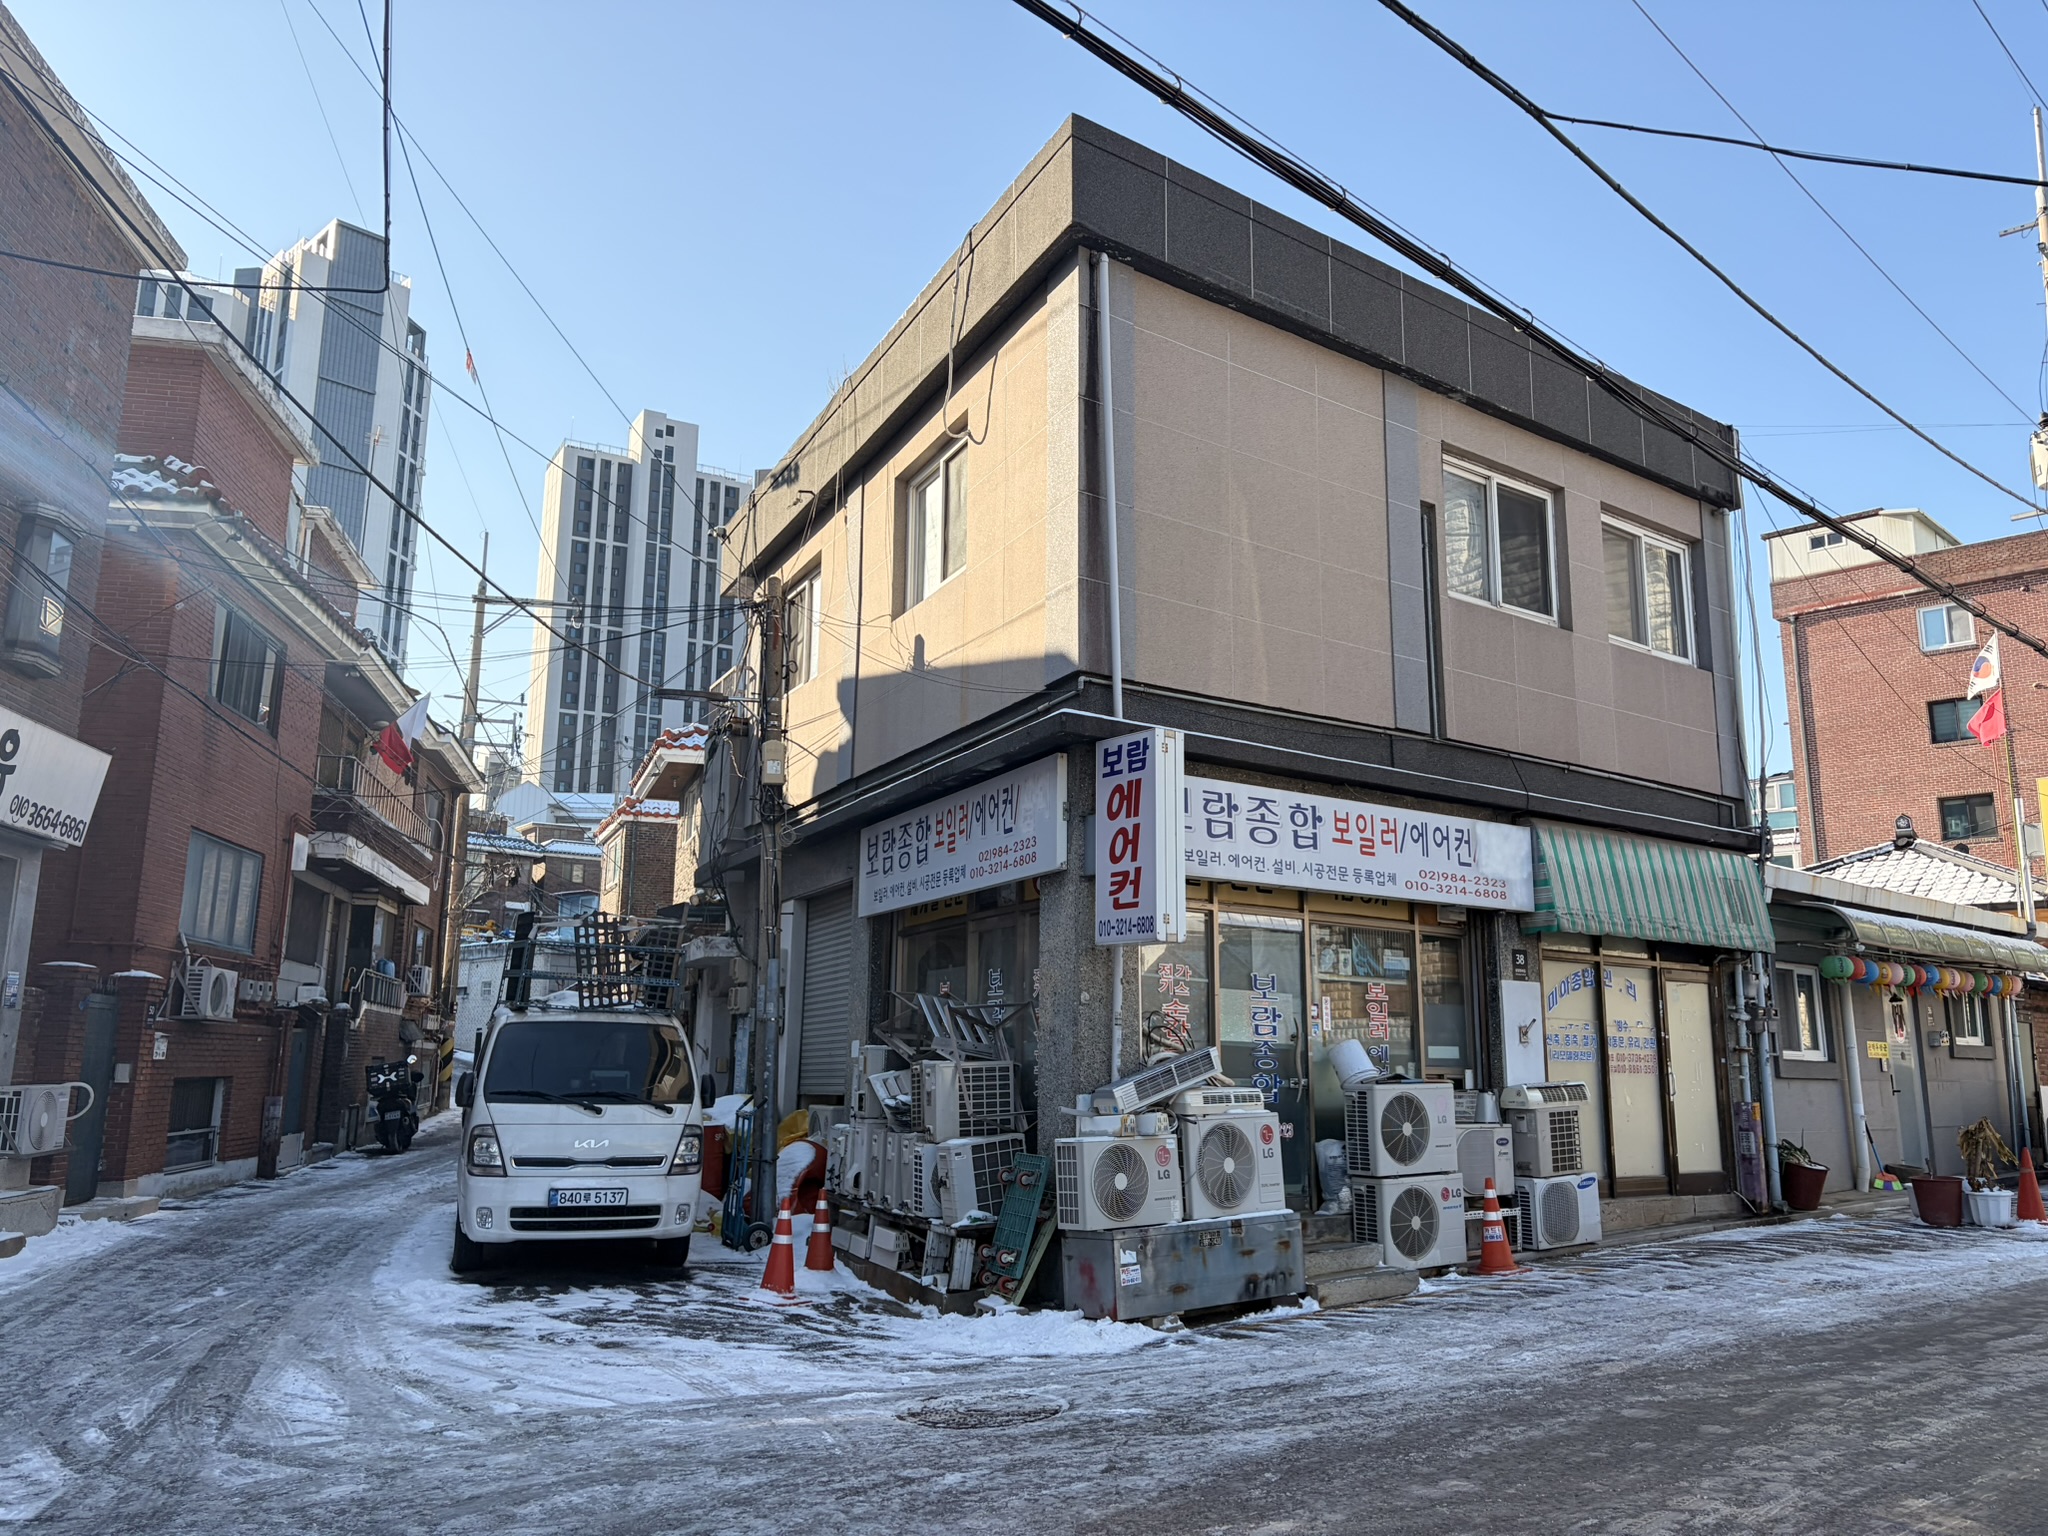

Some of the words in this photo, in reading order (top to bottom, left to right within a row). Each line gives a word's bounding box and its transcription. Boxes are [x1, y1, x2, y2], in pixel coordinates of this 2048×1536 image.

[1102, 737, 1150, 778] 보람
[865, 815, 931, 876] 보람종합
[979, 836, 1037, 863] 02)984-2323
[1107, 778, 1142, 911] 에어컨
[943, 864, 967, 887] 등록업체
[970, 852, 1037, 880] 010-3214-6808
[1352, 868, 1397, 886] 등록업체
[1419, 869, 1507, 889] 02)984-2323
[1405, 880, 1507, 900] 010-3214-6808
[1098, 915, 1155, 938] 010-3214-6808
[1515, 953, 1525, 965] 38
[1547, 967, 1596, 1013] 미아종합
[1365, 982, 1389, 1040] 보일러
[1251, 972, 1284, 1103] 보람종합
[1438, 1115, 1447, 1124] LG
[574, 1139, 610, 1149] KIA
[1262, 1147, 1274, 1159] LG
[1157, 1169, 1171, 1180] LG
[559, 1192, 591, 1205] 840루
[594, 1191, 625, 1204] 5137
[1451, 1188, 1462, 1198] LG
